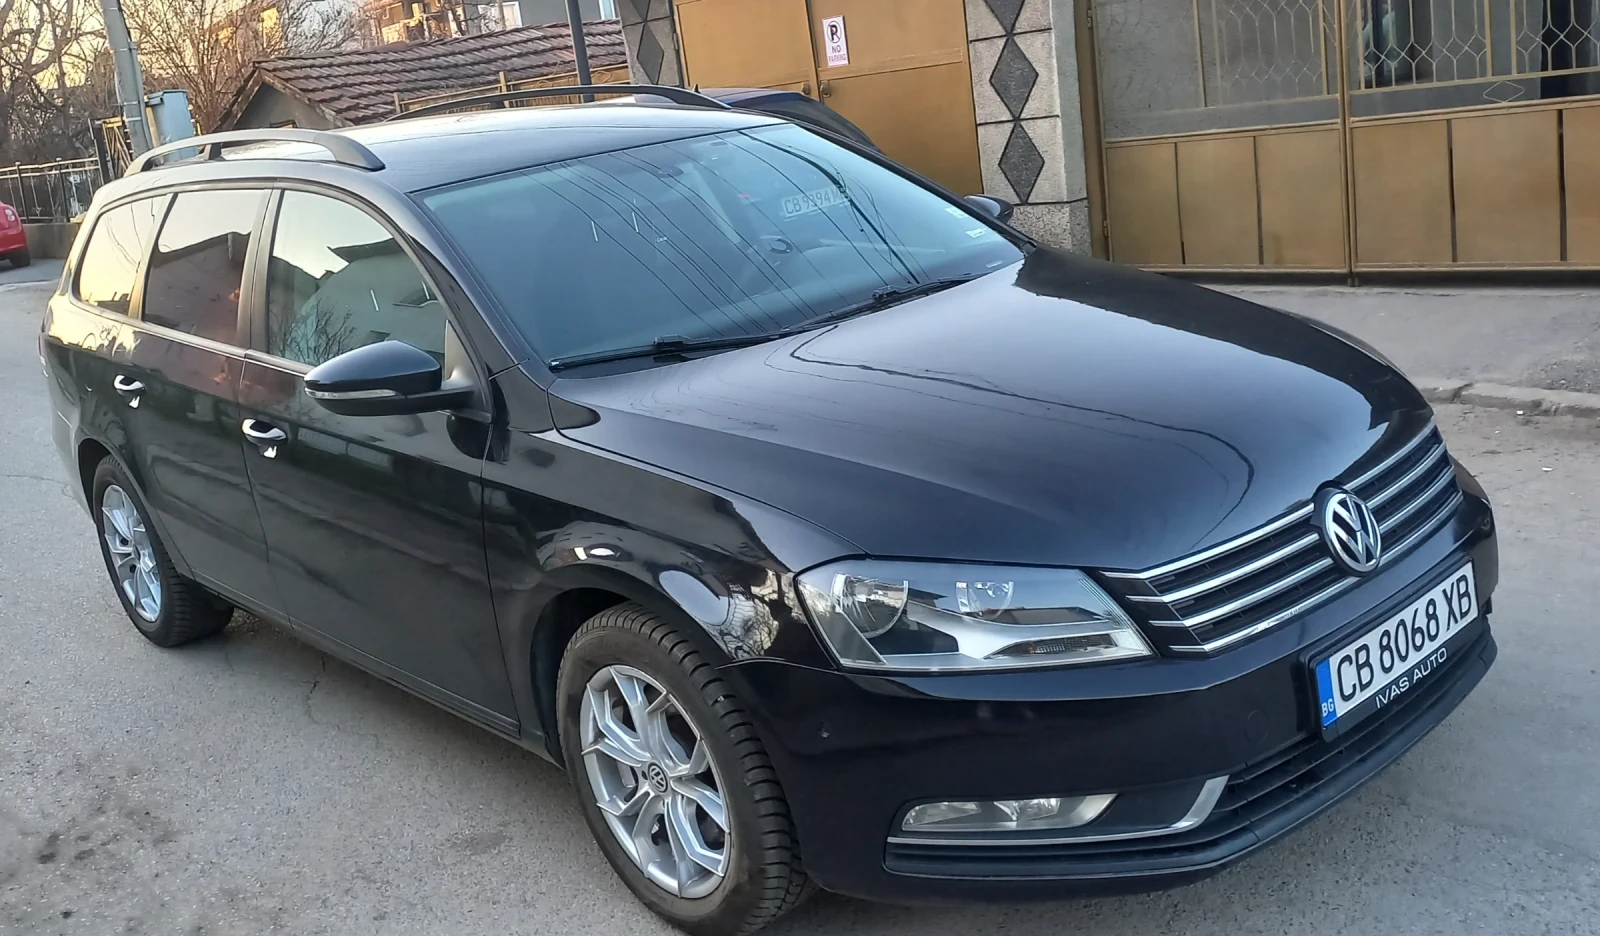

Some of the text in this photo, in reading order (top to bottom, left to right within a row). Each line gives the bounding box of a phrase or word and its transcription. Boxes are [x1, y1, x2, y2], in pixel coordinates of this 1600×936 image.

[831, 44, 842, 53] NO
[784, 197, 802, 215] CB
[1336, 573, 1473, 702] CB 8068 XB
[1375, 647, 1447, 709] IVAS AUTO
[1321, 697, 1335, 718] BG
